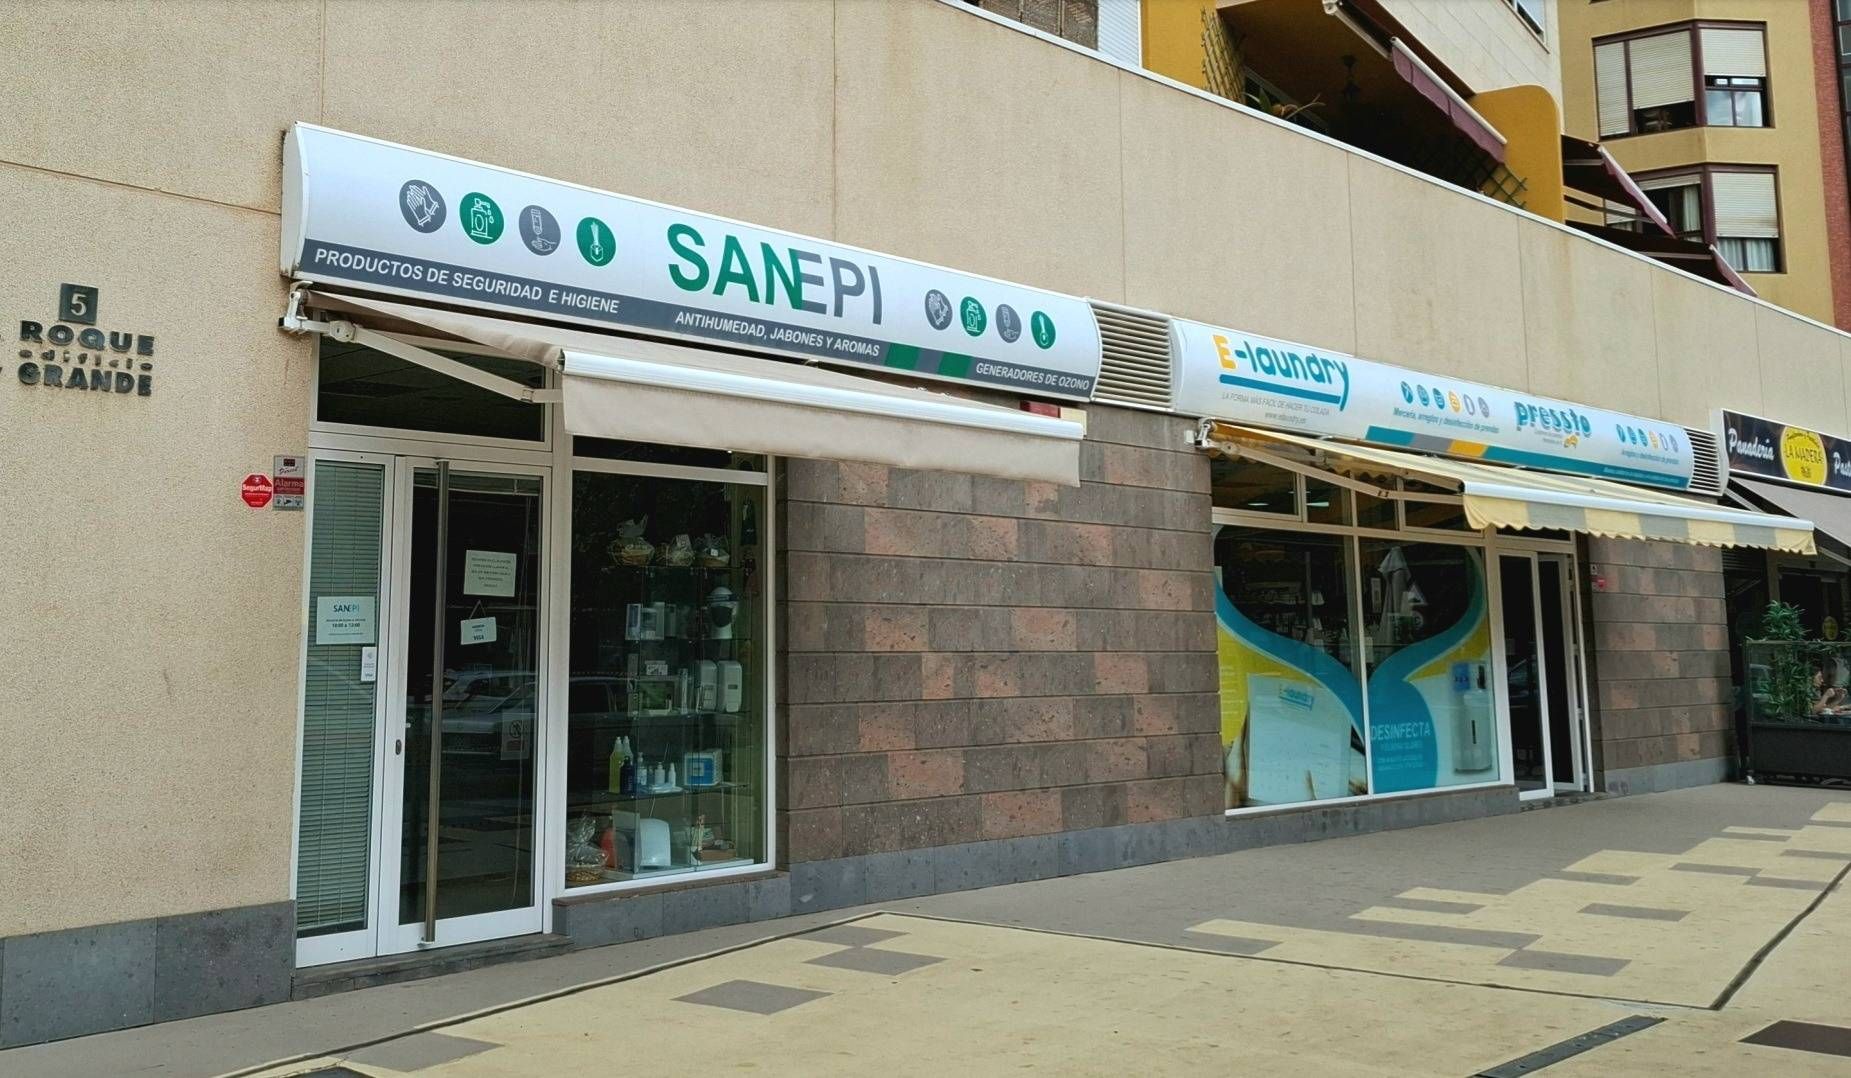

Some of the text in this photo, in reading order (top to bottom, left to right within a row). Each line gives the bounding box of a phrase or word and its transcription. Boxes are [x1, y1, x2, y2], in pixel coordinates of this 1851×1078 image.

[314, 248, 621, 314] PRODUCTOS DE SEGURIDAD E HIGIENE
[667, 223, 883, 326] SANEPI
[70, 293, 88, 317] 5
[20, 320, 154, 356] ROQUE
[675, 311, 880, 358] ANTIHUMEDAD, JABONES Y AROMAS
[18, 362, 153, 396] GRANDE
[975, 362, 1091, 391] GENERADORES DE OZONO
[1211, 334, 1350, 412] E-laundry
[1371, 722, 1431, 740] DESINFECTA
